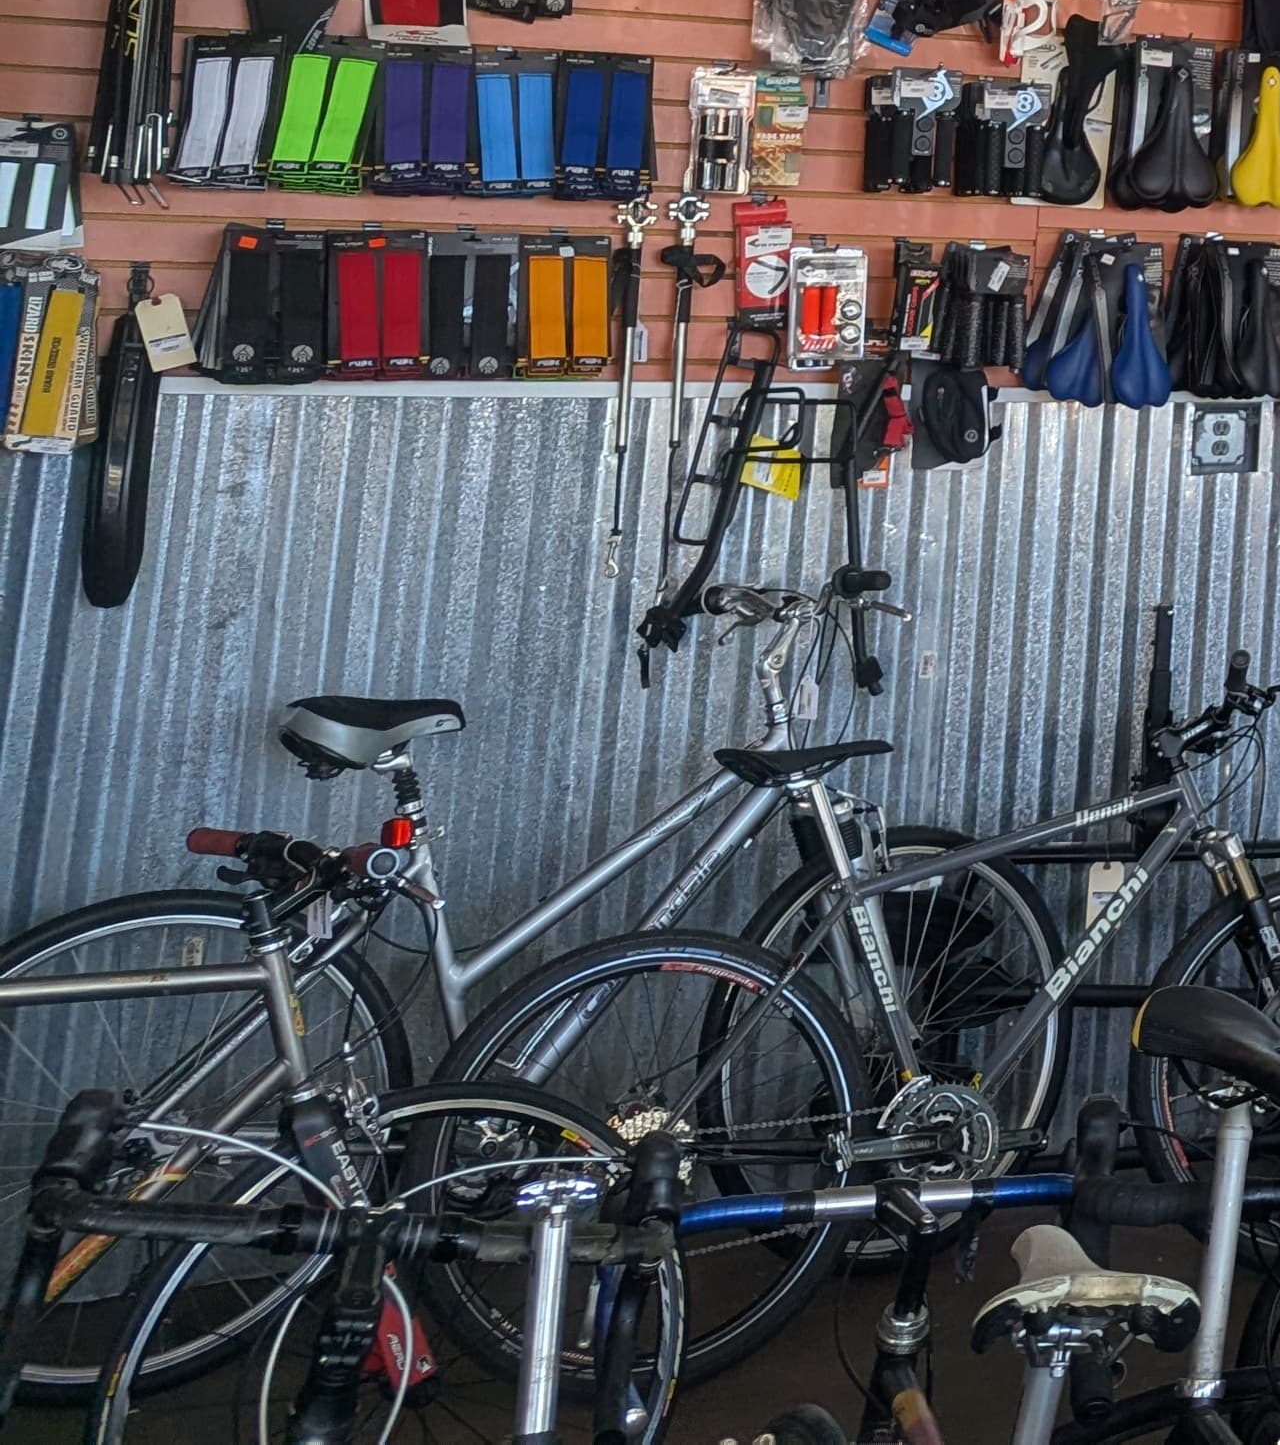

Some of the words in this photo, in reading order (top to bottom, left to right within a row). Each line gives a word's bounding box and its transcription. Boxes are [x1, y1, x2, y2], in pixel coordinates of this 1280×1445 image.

[16, 335, 39, 387] SKINS
[71, 326, 91, 387] SWINGARM
[66, 388, 81, 432] GUARD
[1076, 797, 1134, 826] Denali
[851, 906, 898, 1013] Bianchi
[1045, 864, 1148, 1002] Bianchi
